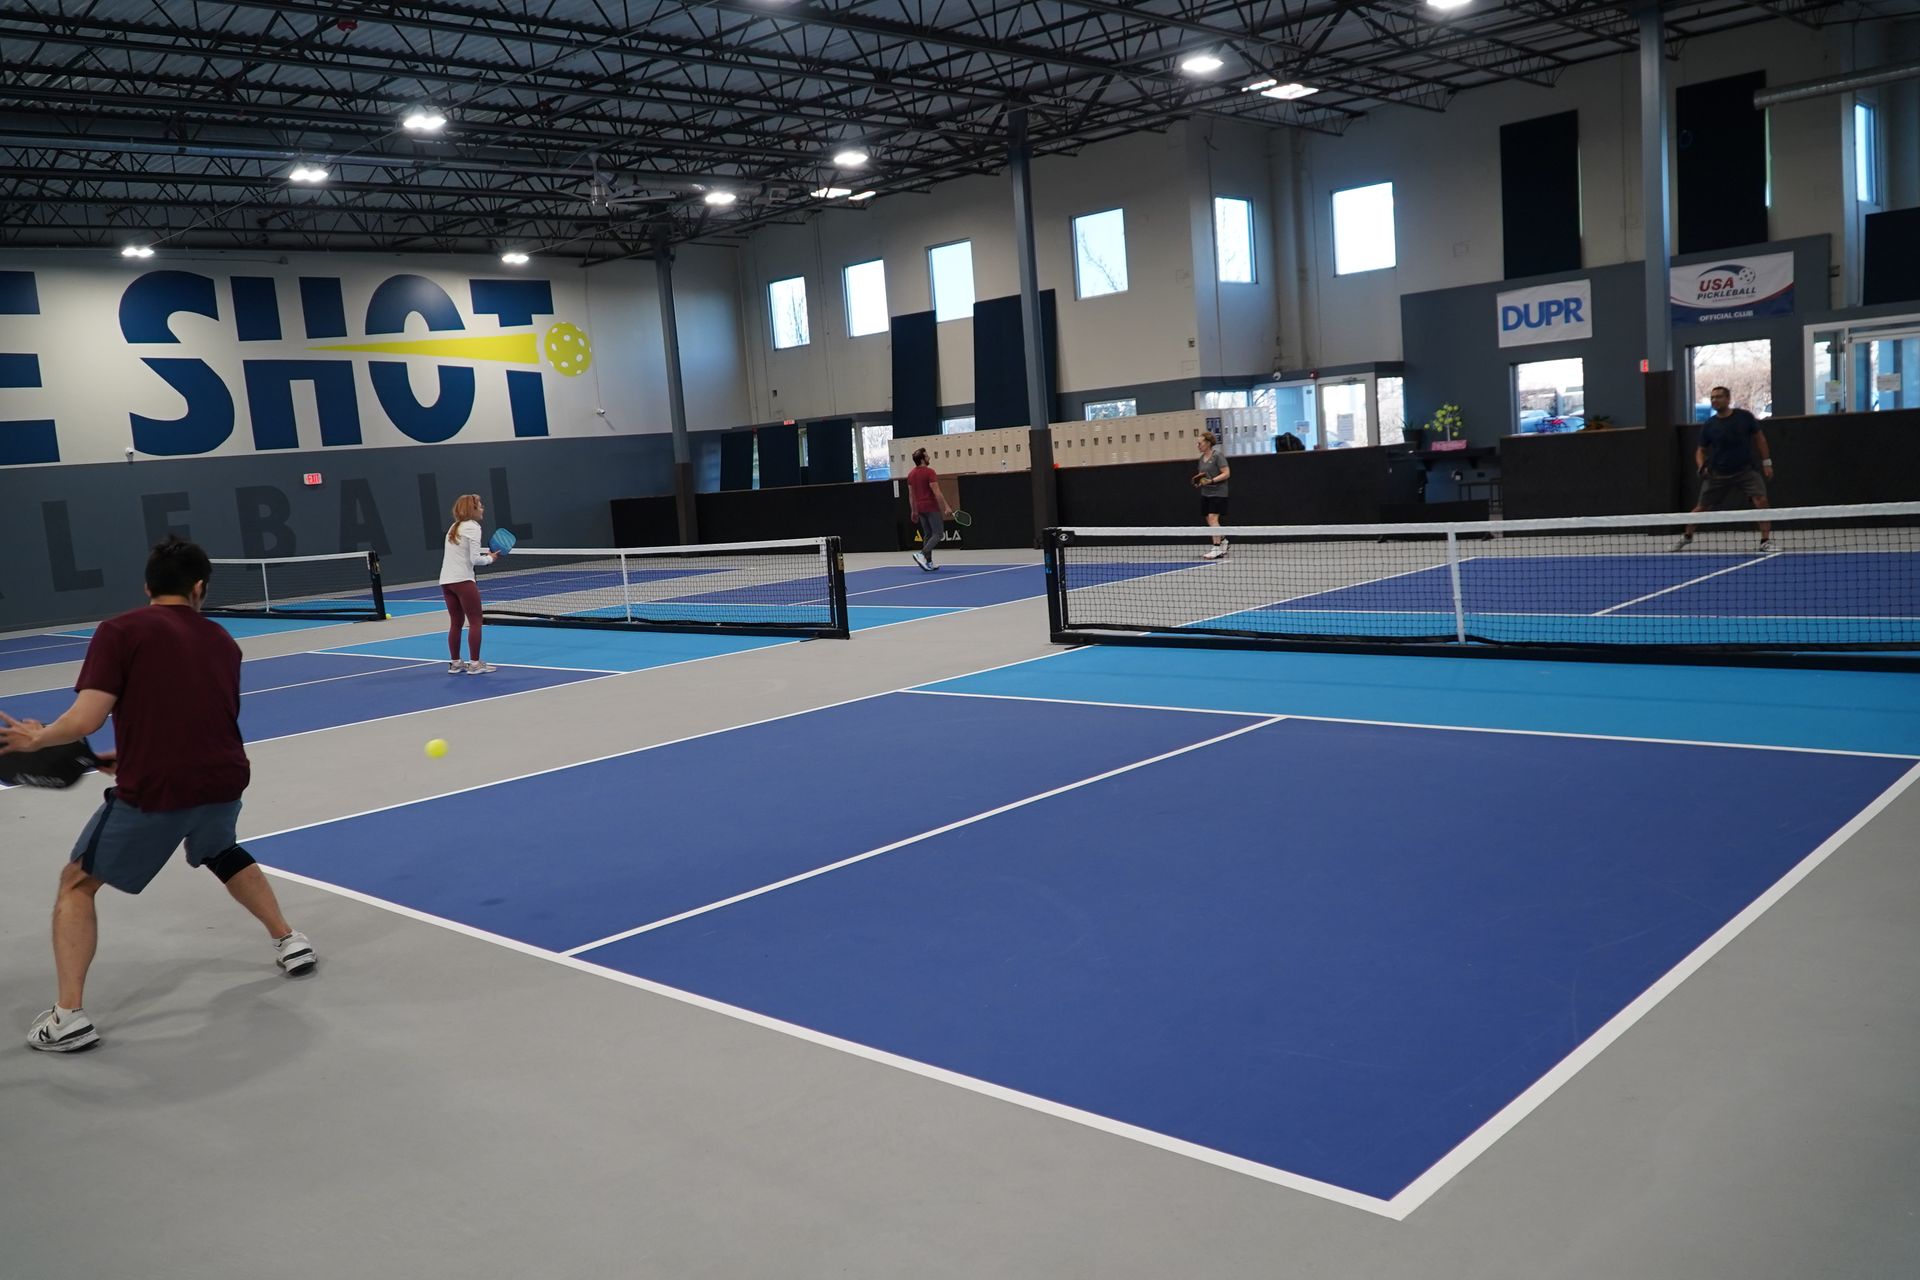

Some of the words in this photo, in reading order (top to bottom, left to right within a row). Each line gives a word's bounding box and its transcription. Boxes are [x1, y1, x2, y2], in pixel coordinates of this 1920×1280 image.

[1699, 277, 1734, 292] USA
[1697, 287, 1757, 300] PICKLEBALL
[1502, 297, 1585, 331] DUPR
[1699, 312, 1732, 322] OFFICIAL
[1734, 309, 1754, 318] CLUB
[119, 270, 553, 457] SHOT
[307, 473, 320, 484] EXIT
[0, 466, 534, 600] LEBALL
